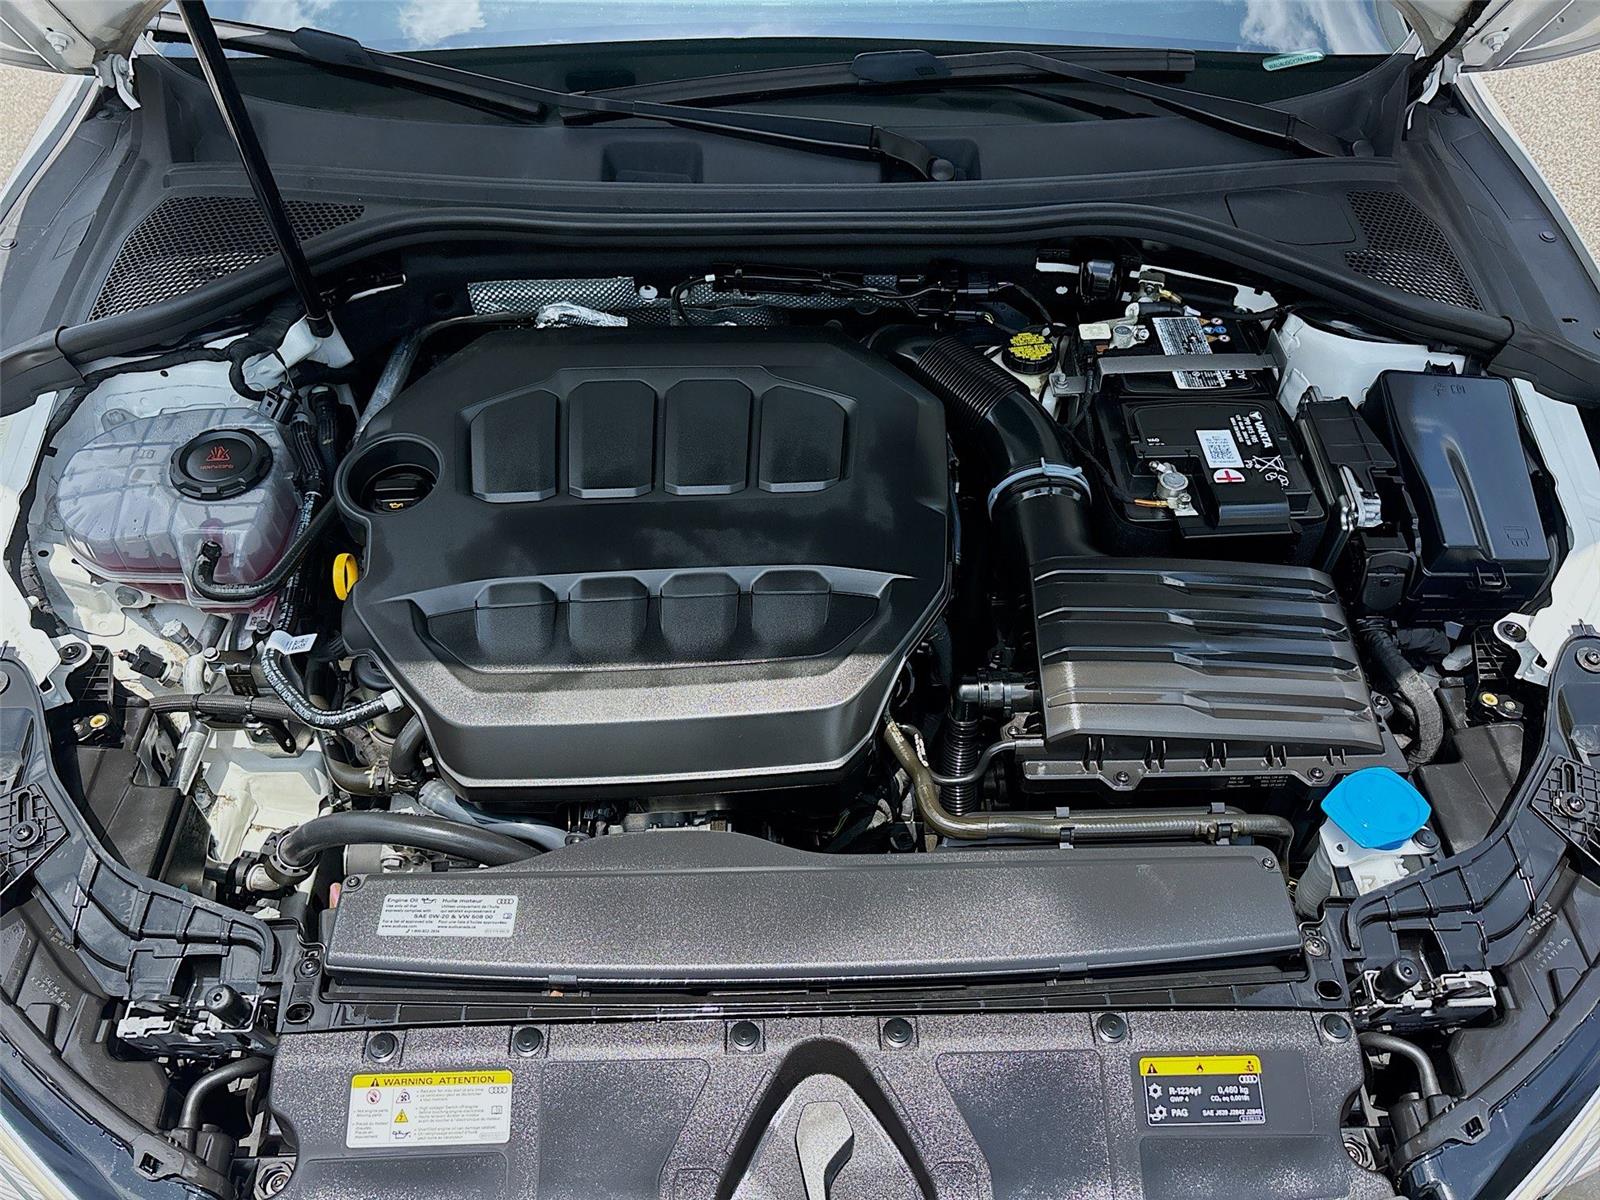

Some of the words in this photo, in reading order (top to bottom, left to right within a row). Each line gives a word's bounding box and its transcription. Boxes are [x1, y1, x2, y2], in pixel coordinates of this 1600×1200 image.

[1255, 420, 1273, 449] VARTA
[383, 1077, 433, 1087] WARNING
[438, 1075, 495, 1085] ATTENTION
[1168, 1086, 1202, 1097] R-1234yf
[1239, 1086, 1249, 1095] kg
[1171, 1108, 1189, 1117] PAG
[1202, 1109, 1214, 1117] SAE
